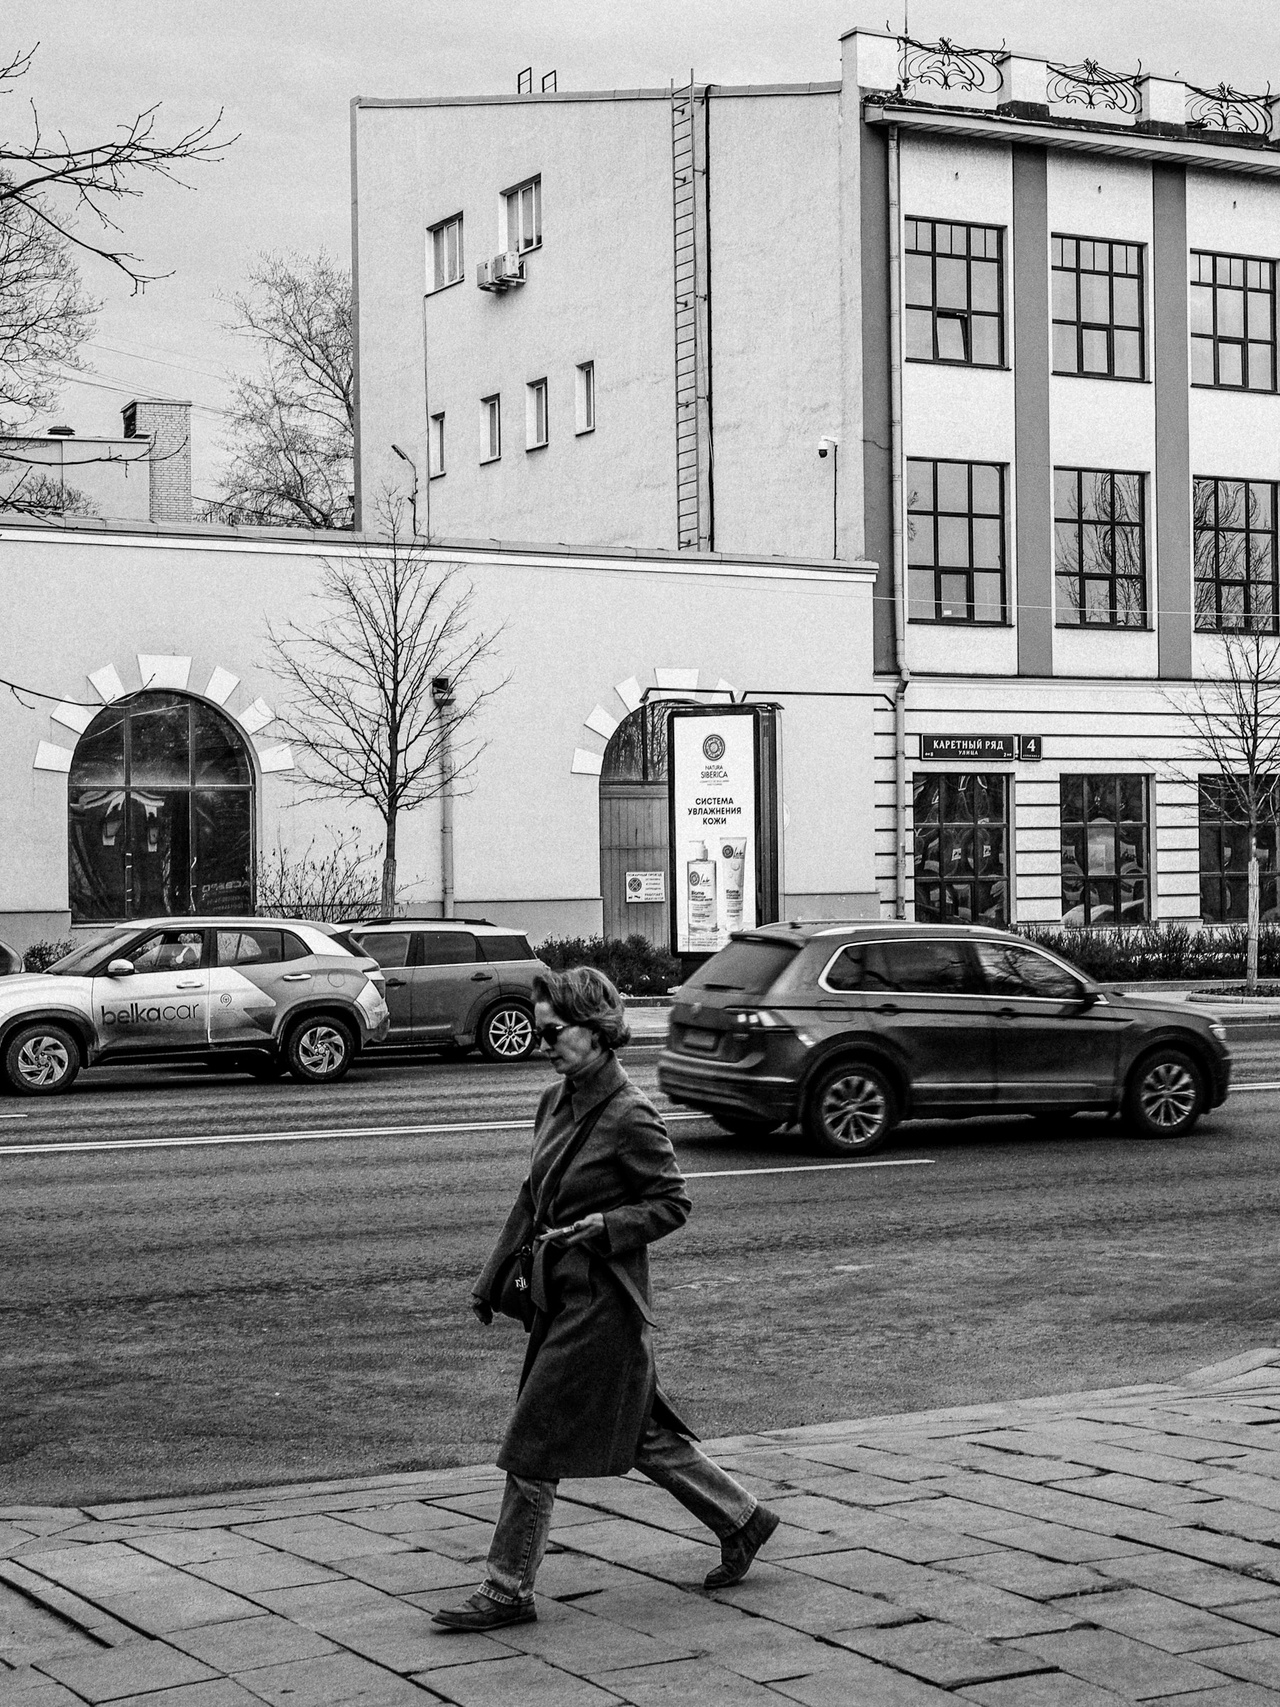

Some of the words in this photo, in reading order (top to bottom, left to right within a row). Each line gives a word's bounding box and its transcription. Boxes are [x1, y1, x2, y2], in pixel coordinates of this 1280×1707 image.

[934, 739, 982, 749] КАРЕТНЫЙ
[986, 741, 1004, 750] РЯД
[1027, 739, 1036, 751] 4
[695, 797, 734, 805] СИСТЕМА
[688, 807, 741, 815] УВЛАЖНЕНИЯ
[703, 817, 726, 825] КОЖИ
[101, 1003, 199, 1025] belkacar
